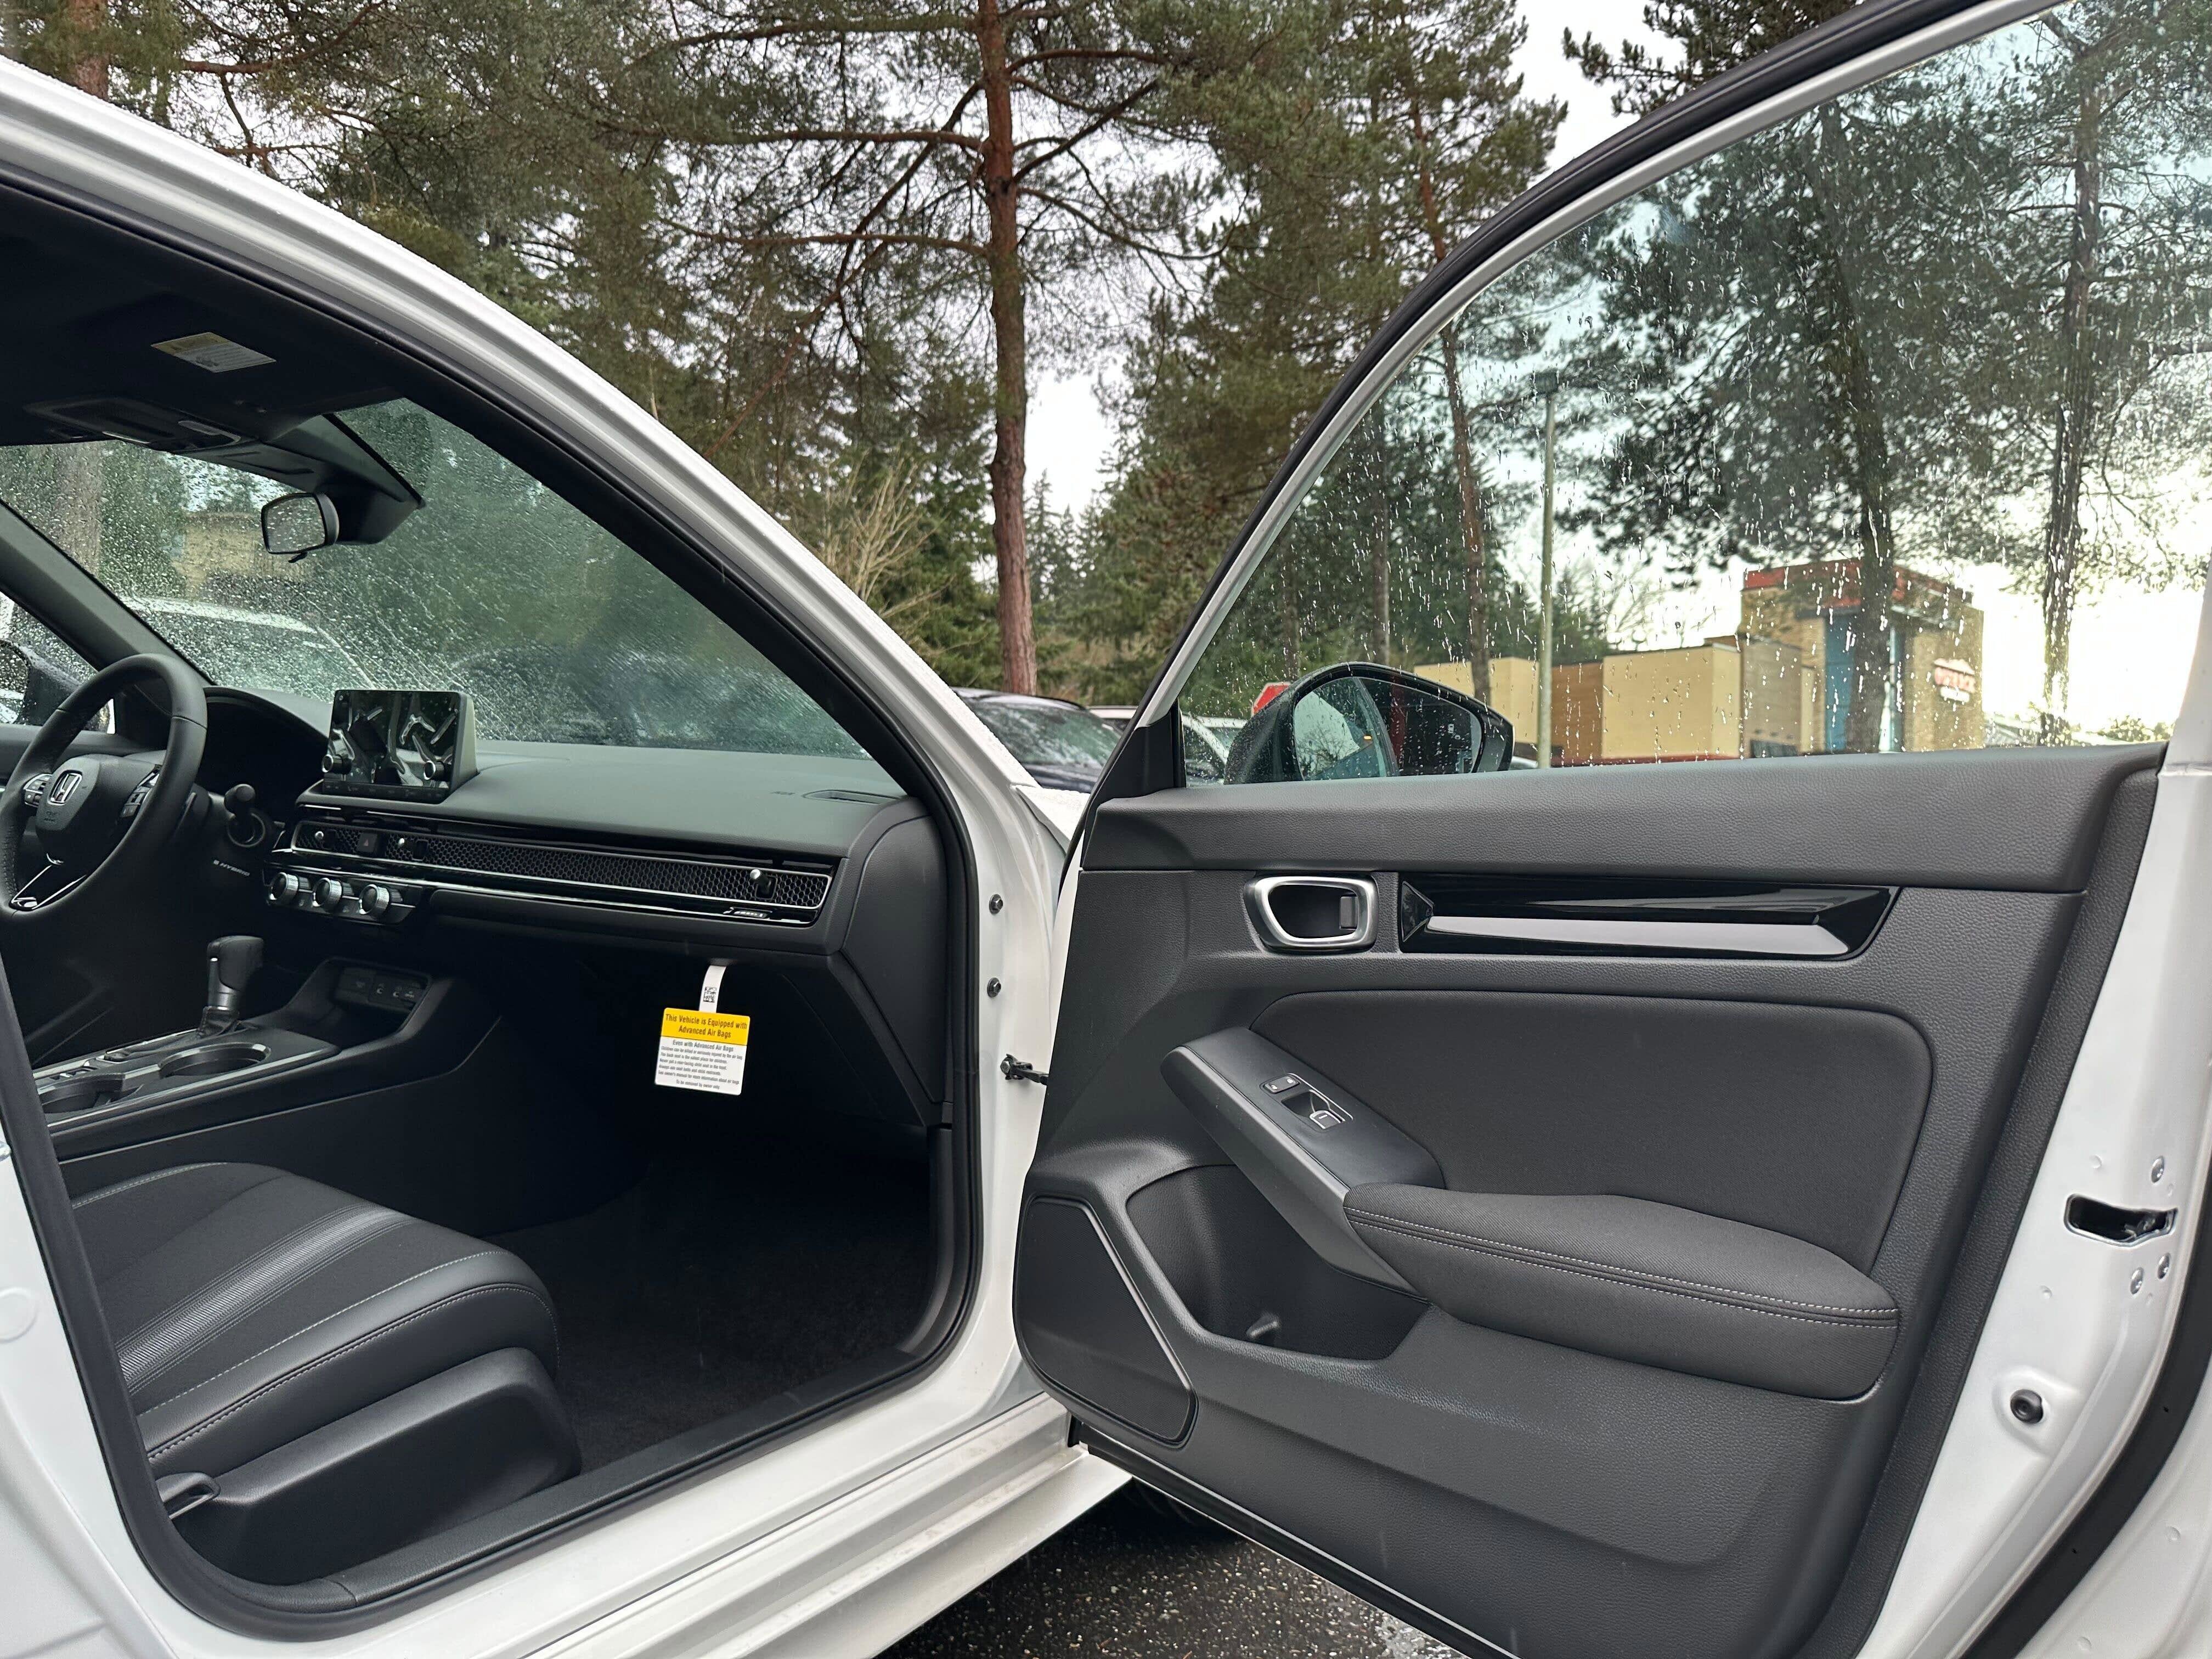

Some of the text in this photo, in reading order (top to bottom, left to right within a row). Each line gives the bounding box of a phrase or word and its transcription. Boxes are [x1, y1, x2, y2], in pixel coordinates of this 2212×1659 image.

[679, 1015, 699, 1024] Vehicle
[708, 1018, 733, 1028] Equipped
[679, 1025, 706, 1035] Advanced
[717, 1030, 731, 1039] Bags
